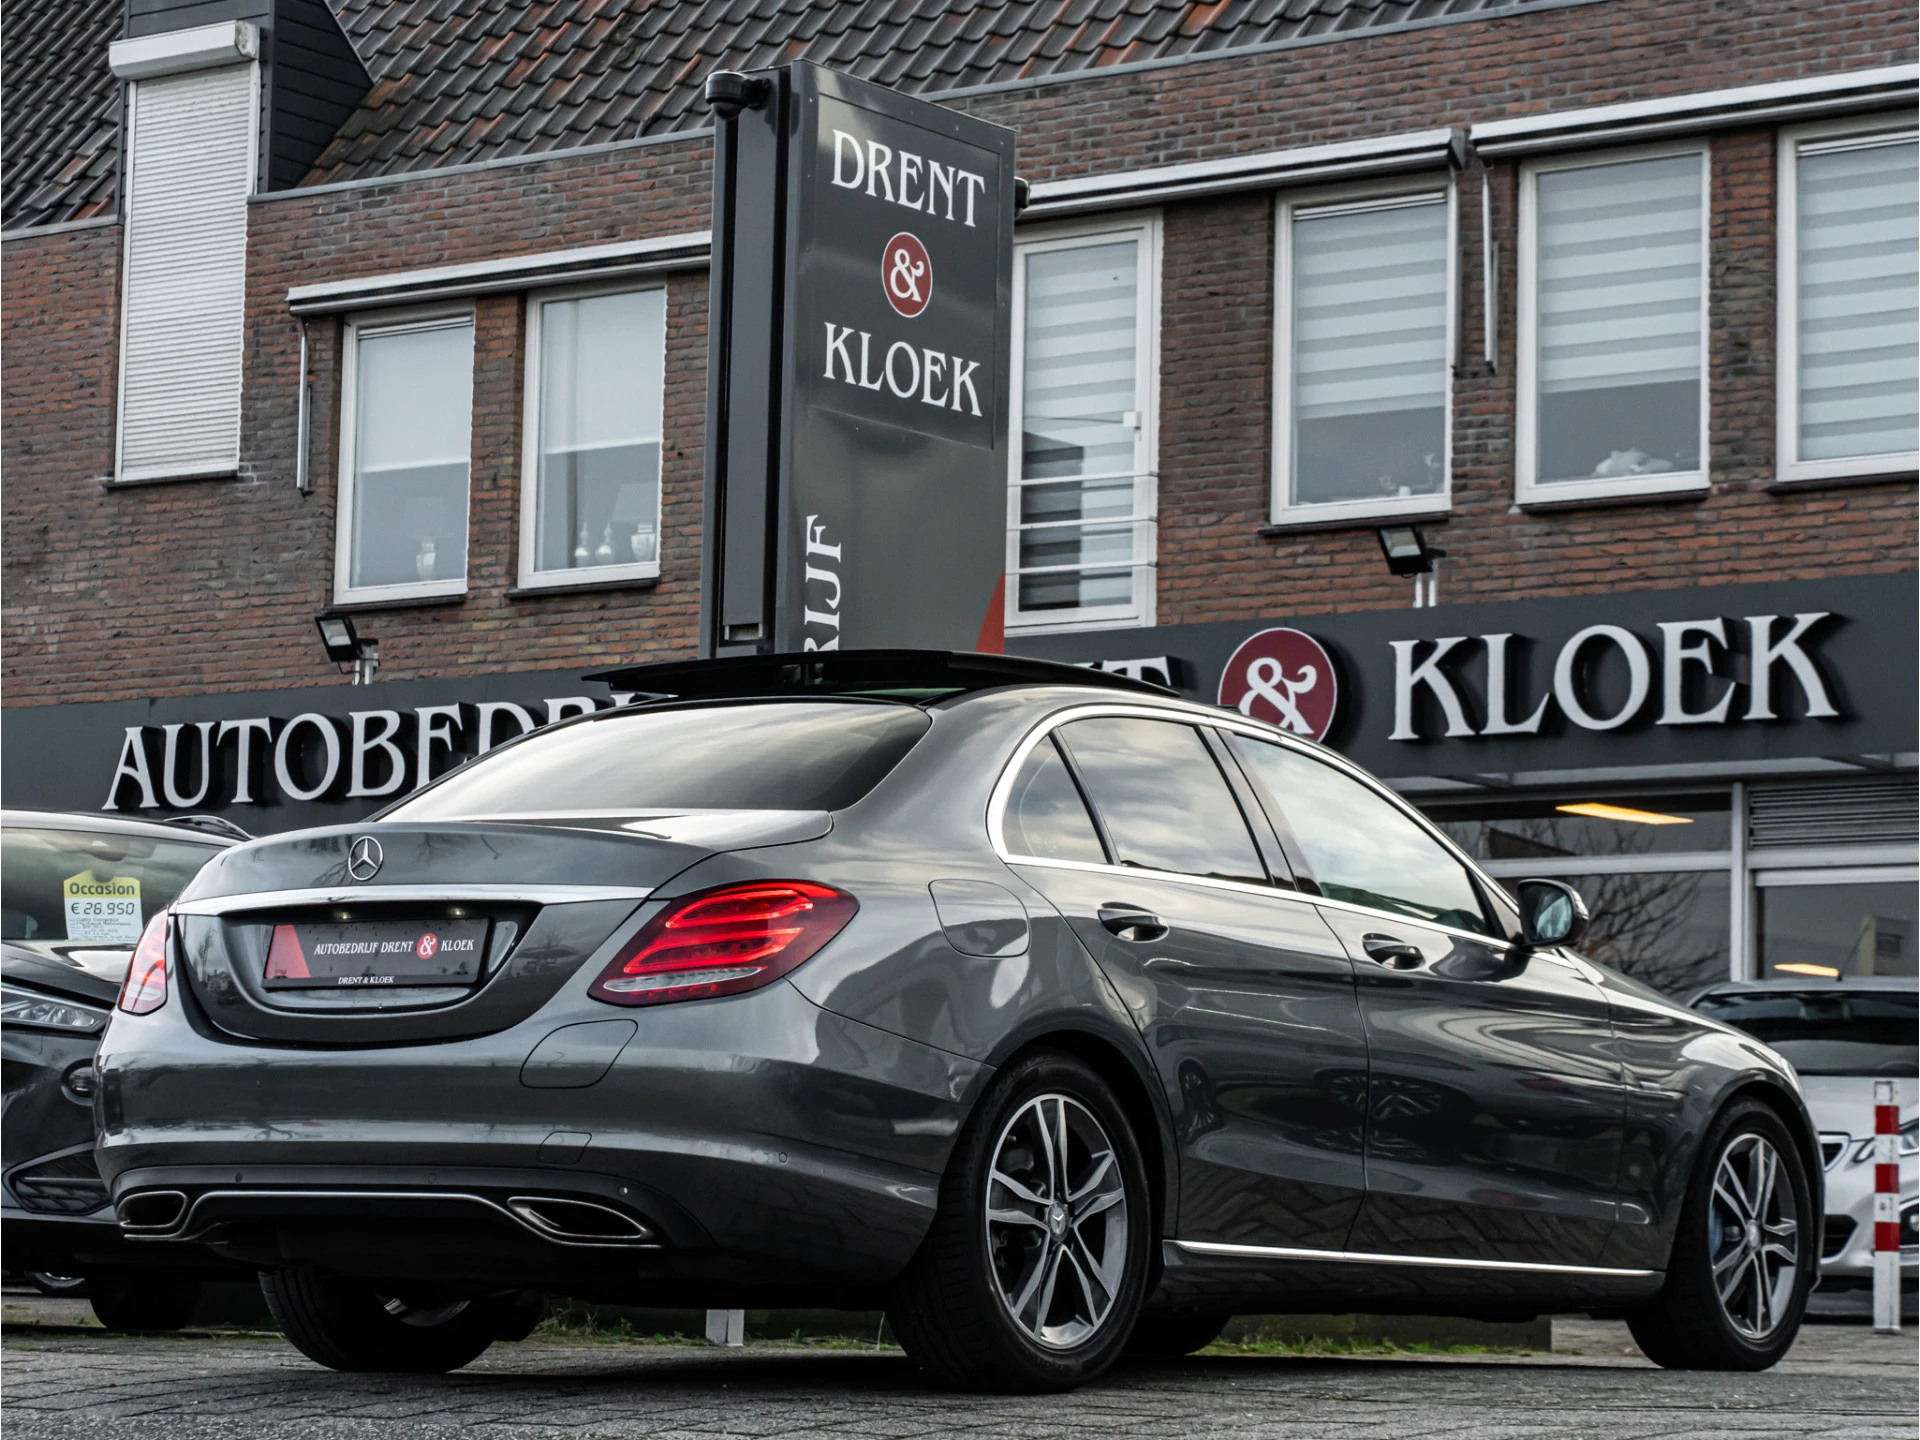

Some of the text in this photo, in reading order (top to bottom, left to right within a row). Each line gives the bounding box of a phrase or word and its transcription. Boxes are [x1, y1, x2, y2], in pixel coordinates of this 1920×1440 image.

[831, 129, 985, 227] DRENT
[890, 249, 924, 302] &
[823, 322, 982, 417] KLOEK
[1238, 657, 1315, 735] &
[1388, 612, 1839, 740] KLOEK
[69, 883, 135, 895] Occasion
[71, 903, 135, 915] € 26.950
[313, 936, 474, 955] AUTOBEDRIJF DRENT & KLOEK
[338, 976, 363, 984] DRENT
[370, 976, 394, 984] KLOEK
